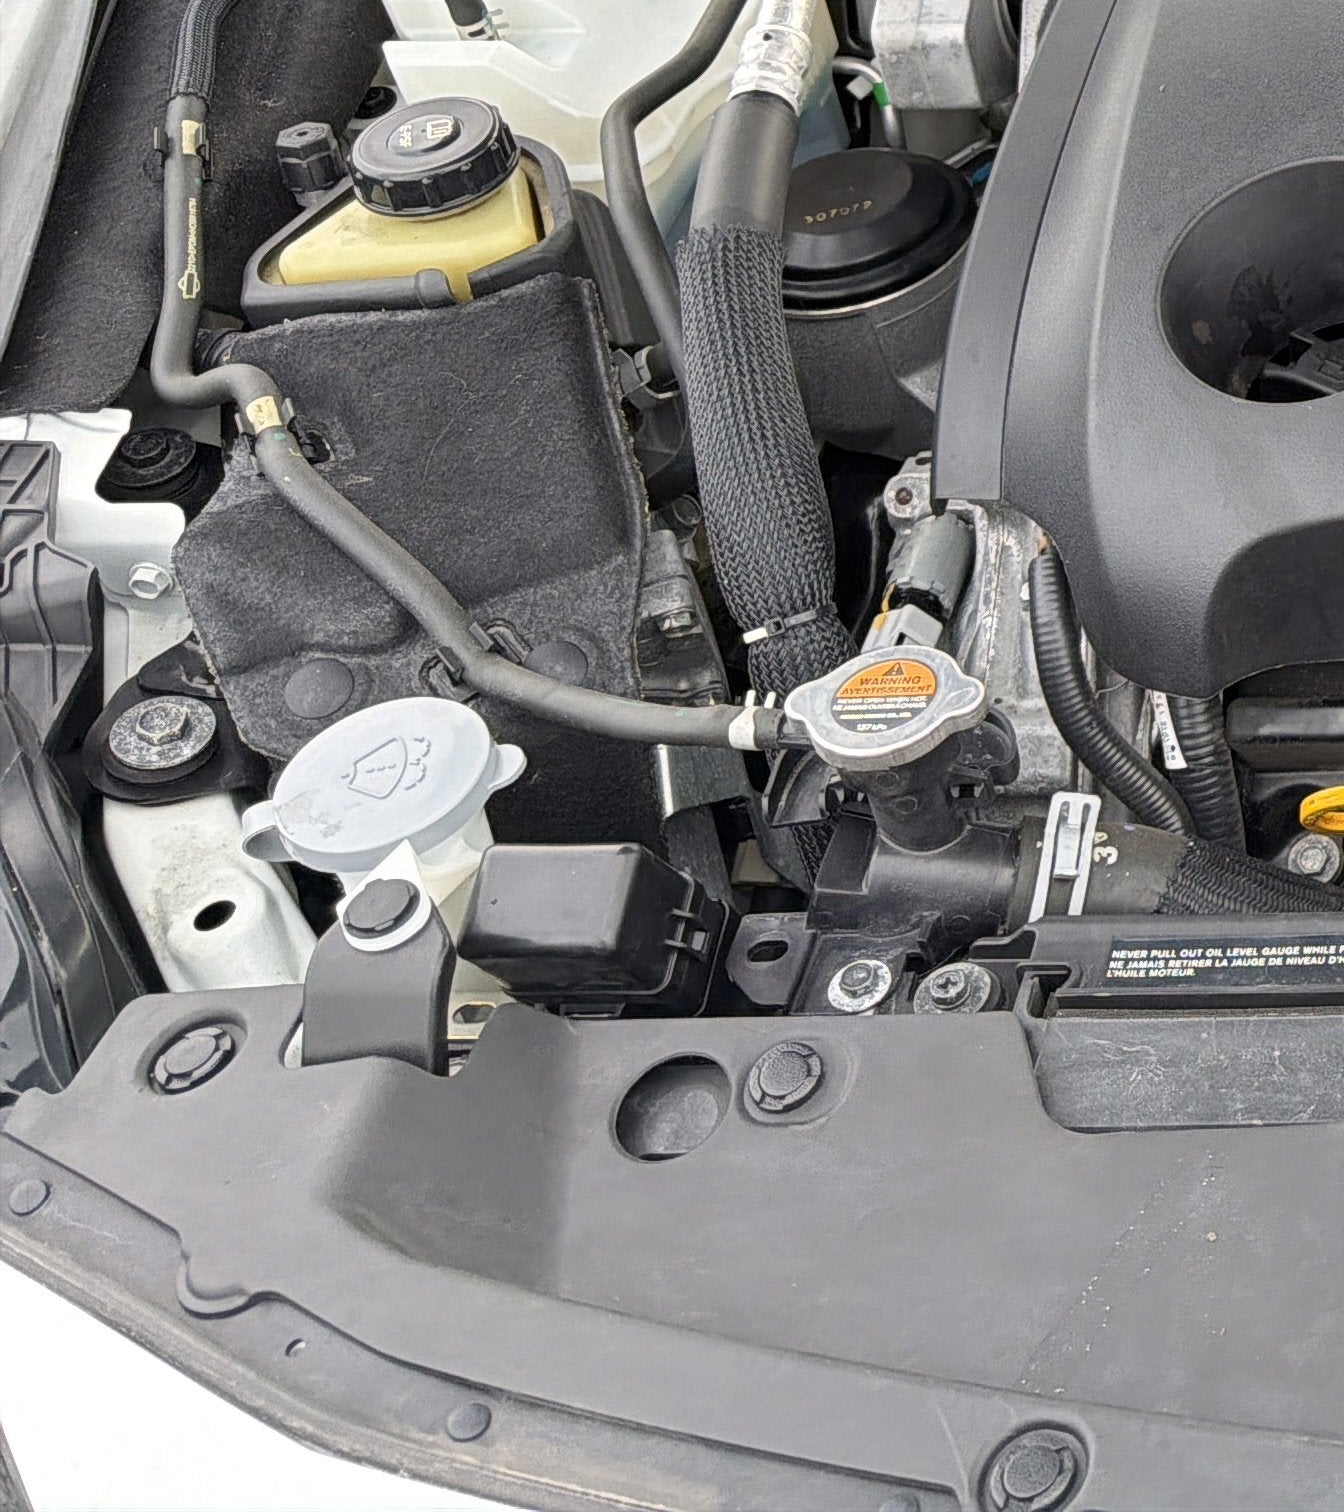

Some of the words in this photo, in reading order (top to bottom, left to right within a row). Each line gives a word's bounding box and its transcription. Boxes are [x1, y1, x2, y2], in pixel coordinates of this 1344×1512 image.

[860, 676, 921, 686] WARNING
[842, 685, 932, 694] AVERTISSEMENT
[1111, 949, 1148, 959] NEVER
[1150, 949, 1177, 958] PULL
[1180, 948, 1203, 958] OUT
[1205, 948, 1223, 958] OIL
[1226, 947, 1258, 957] LEVEL
[1261, 946, 1300, 956] GAUGE
[1302, 944, 1336, 955] WHILE
[1109, 960, 1124, 969] NE
[1126, 960, 1165, 969] JAMAIS
[1167, 958, 1212, 968] RETIRER
[1214, 958, 1229, 968] LA
[1230, 957, 1266, 967] JAUGE
[1268, 957, 1283, 966] DE
[1285, 956, 1326, 966] NIVEAU
[1105, 969, 1146, 978] L'HUILE
[1148, 968, 1196, 977] MOTEUR.
